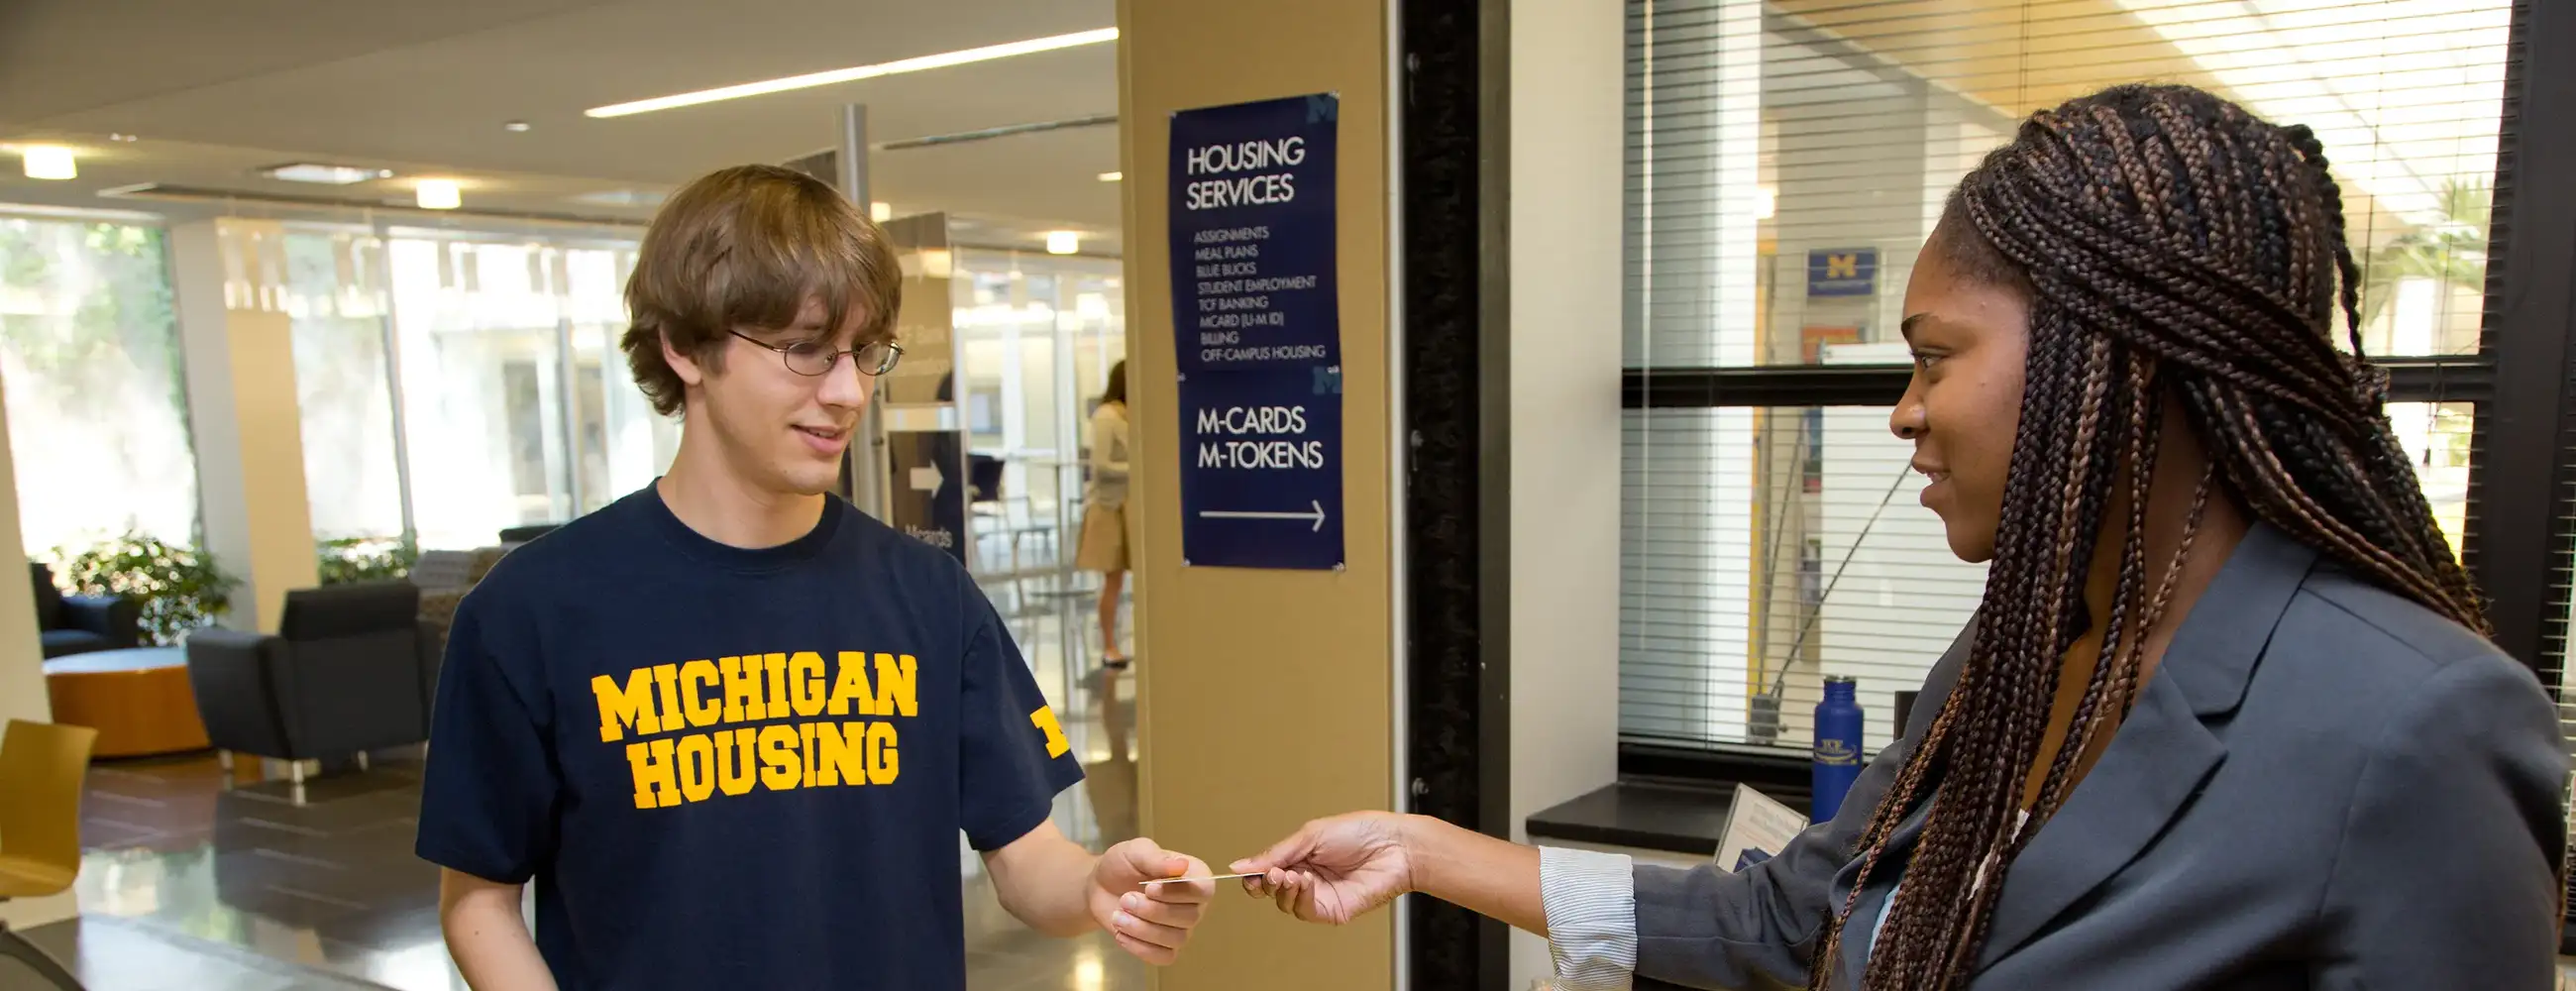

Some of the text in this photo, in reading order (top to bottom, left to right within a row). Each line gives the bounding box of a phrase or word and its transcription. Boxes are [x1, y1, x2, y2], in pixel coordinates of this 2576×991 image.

[1306, 95, 1337, 124] M
[1188, 136, 1306, 175] HOUSING
[1186, 172, 1295, 210] SERVICES
[1193, 225, 1269, 244] ASSIGNMENTS
[1195, 244, 1259, 261] MEAL PLANS
[1196, 262, 1256, 277] BLUE BUCKS
[1828, 253, 1856, 278] M
[1197, 275, 1317, 295] STUDENT EMPLOYMENT
[1198, 295, 1269, 311] TCF BANKING
[1200, 314, 1239, 329] MCARD
[1200, 331, 1239, 346] BILLING
[1201, 344, 1327, 363] OFF-CAMPUS HOUSING
[1197, 405, 1307, 435] M-CARDS
[1197, 441, 1325, 470] M-TOKENS
[591, 650, 918, 743] MICHIGAN
[626, 721, 900, 810] HOUSING
